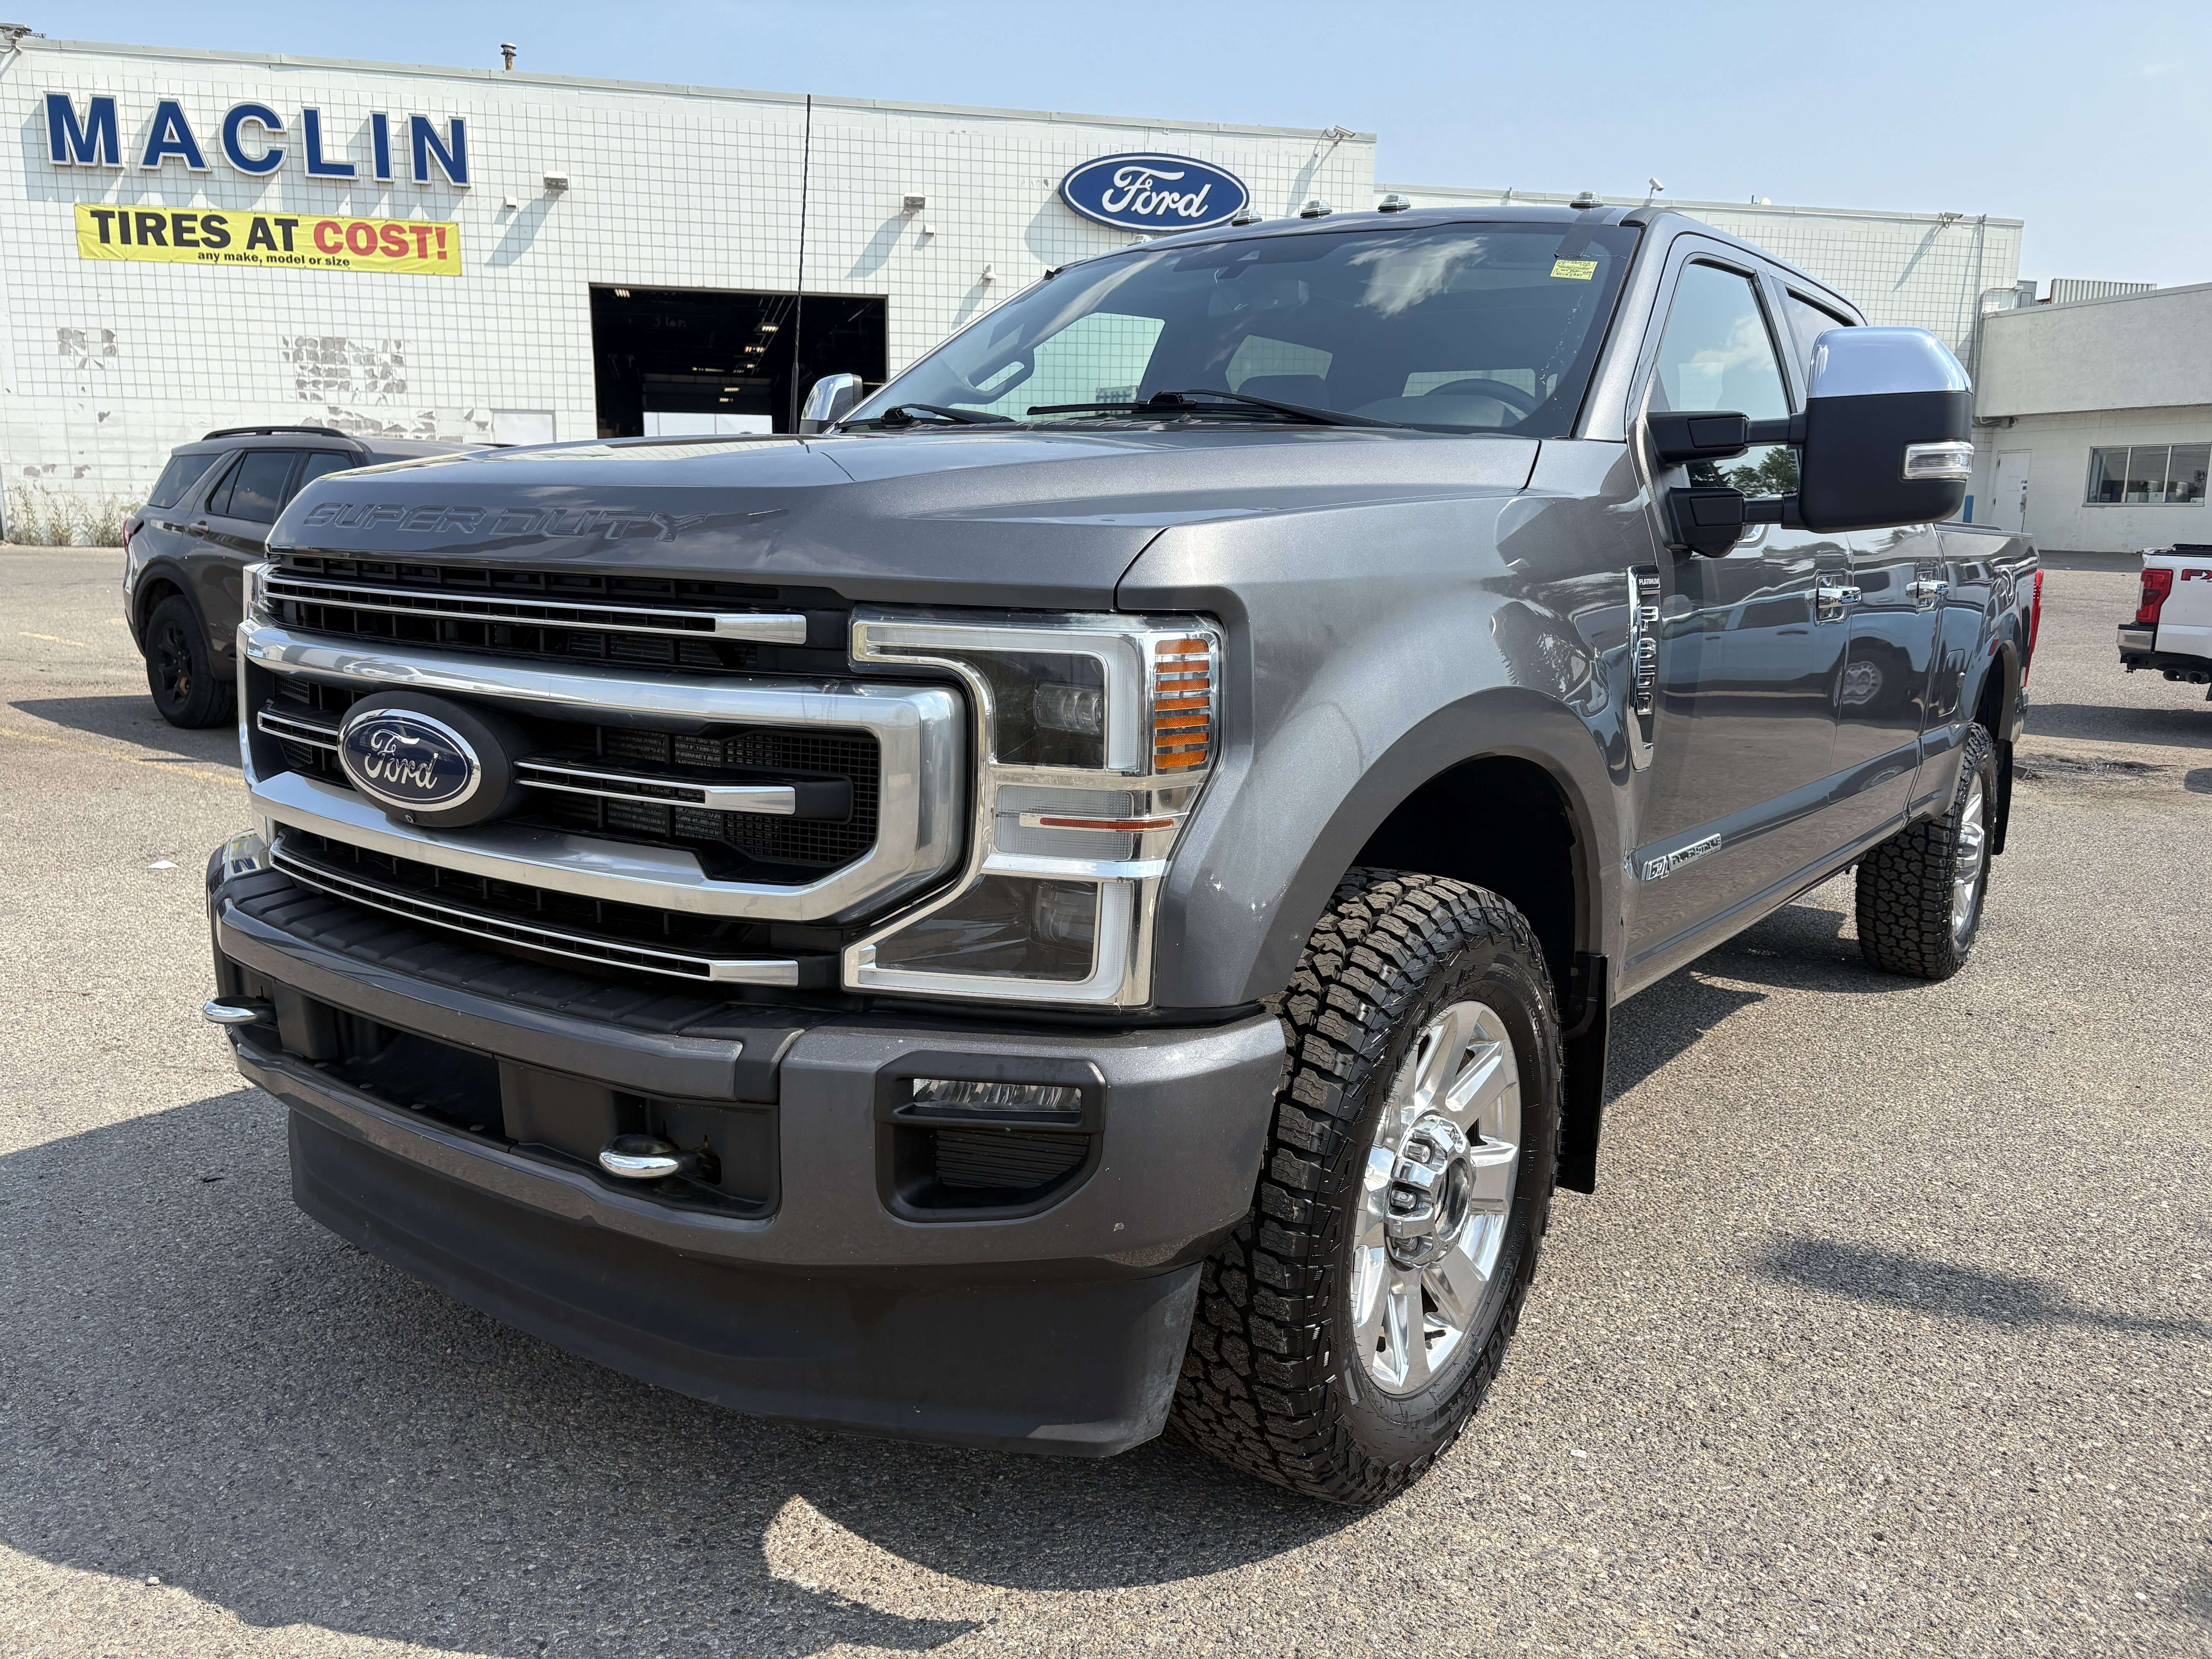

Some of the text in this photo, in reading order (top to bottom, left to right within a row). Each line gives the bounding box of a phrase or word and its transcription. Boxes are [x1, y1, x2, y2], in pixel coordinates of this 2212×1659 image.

[43, 91, 471, 187] MACLIN
[1102, 166, 1212, 218] Ford
[90, 210, 448, 260] TIRES AT COST!
[198, 252, 220, 263] any
[224, 252, 263, 263] make,
[266, 254, 305, 264] model
[325, 256, 350, 266] size
[303, 502, 709, 542] SUPER DUTY
[364, 729, 440, 789] Ford
